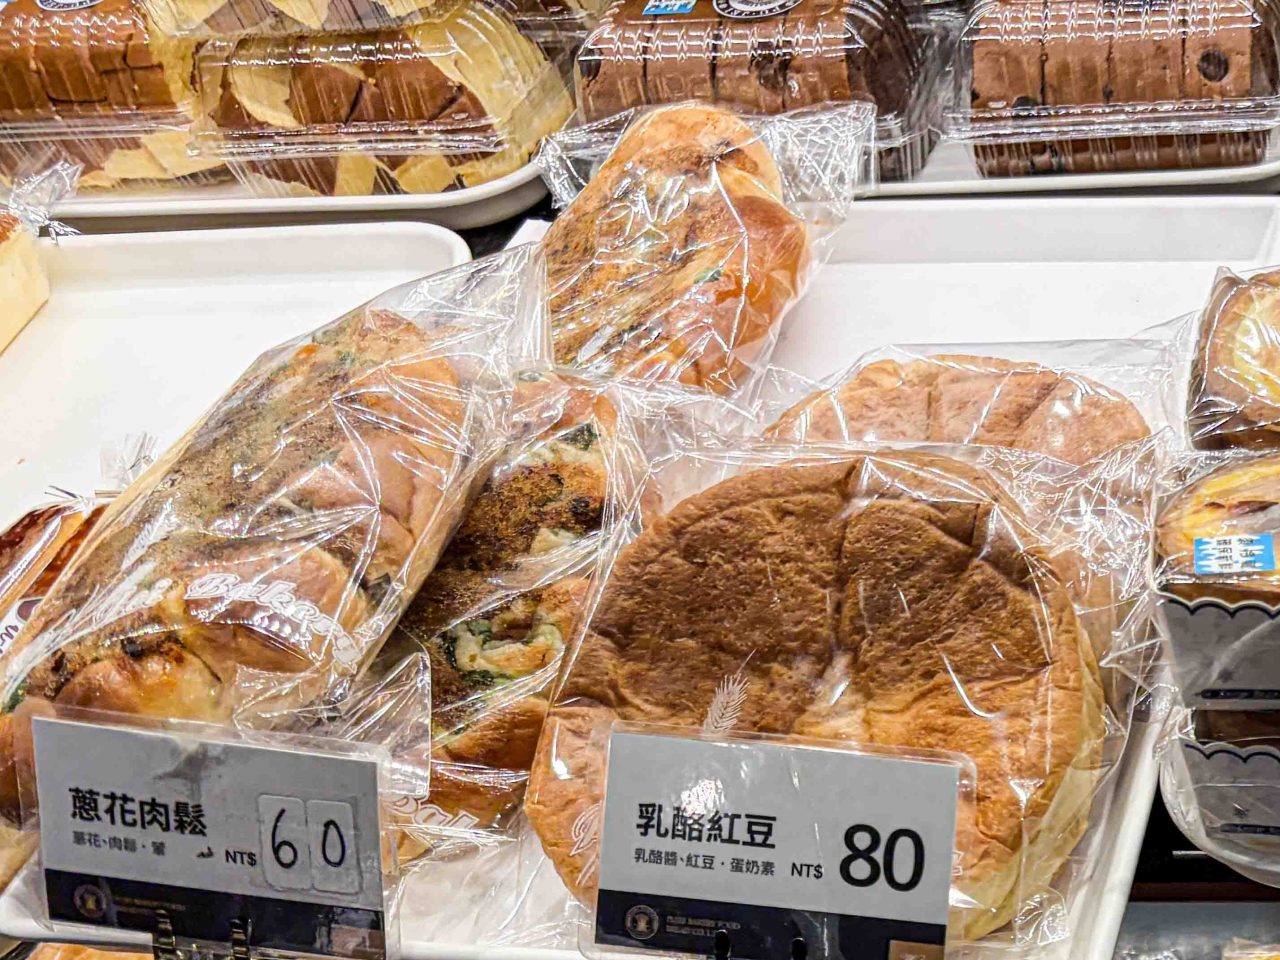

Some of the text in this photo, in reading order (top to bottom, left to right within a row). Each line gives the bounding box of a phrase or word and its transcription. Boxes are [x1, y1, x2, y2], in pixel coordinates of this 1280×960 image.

[272, 808, 347, 869] 60
[636, 803, 777, 849] 乳酪紅豆
[791, 823, 925, 892] NT$ 80
